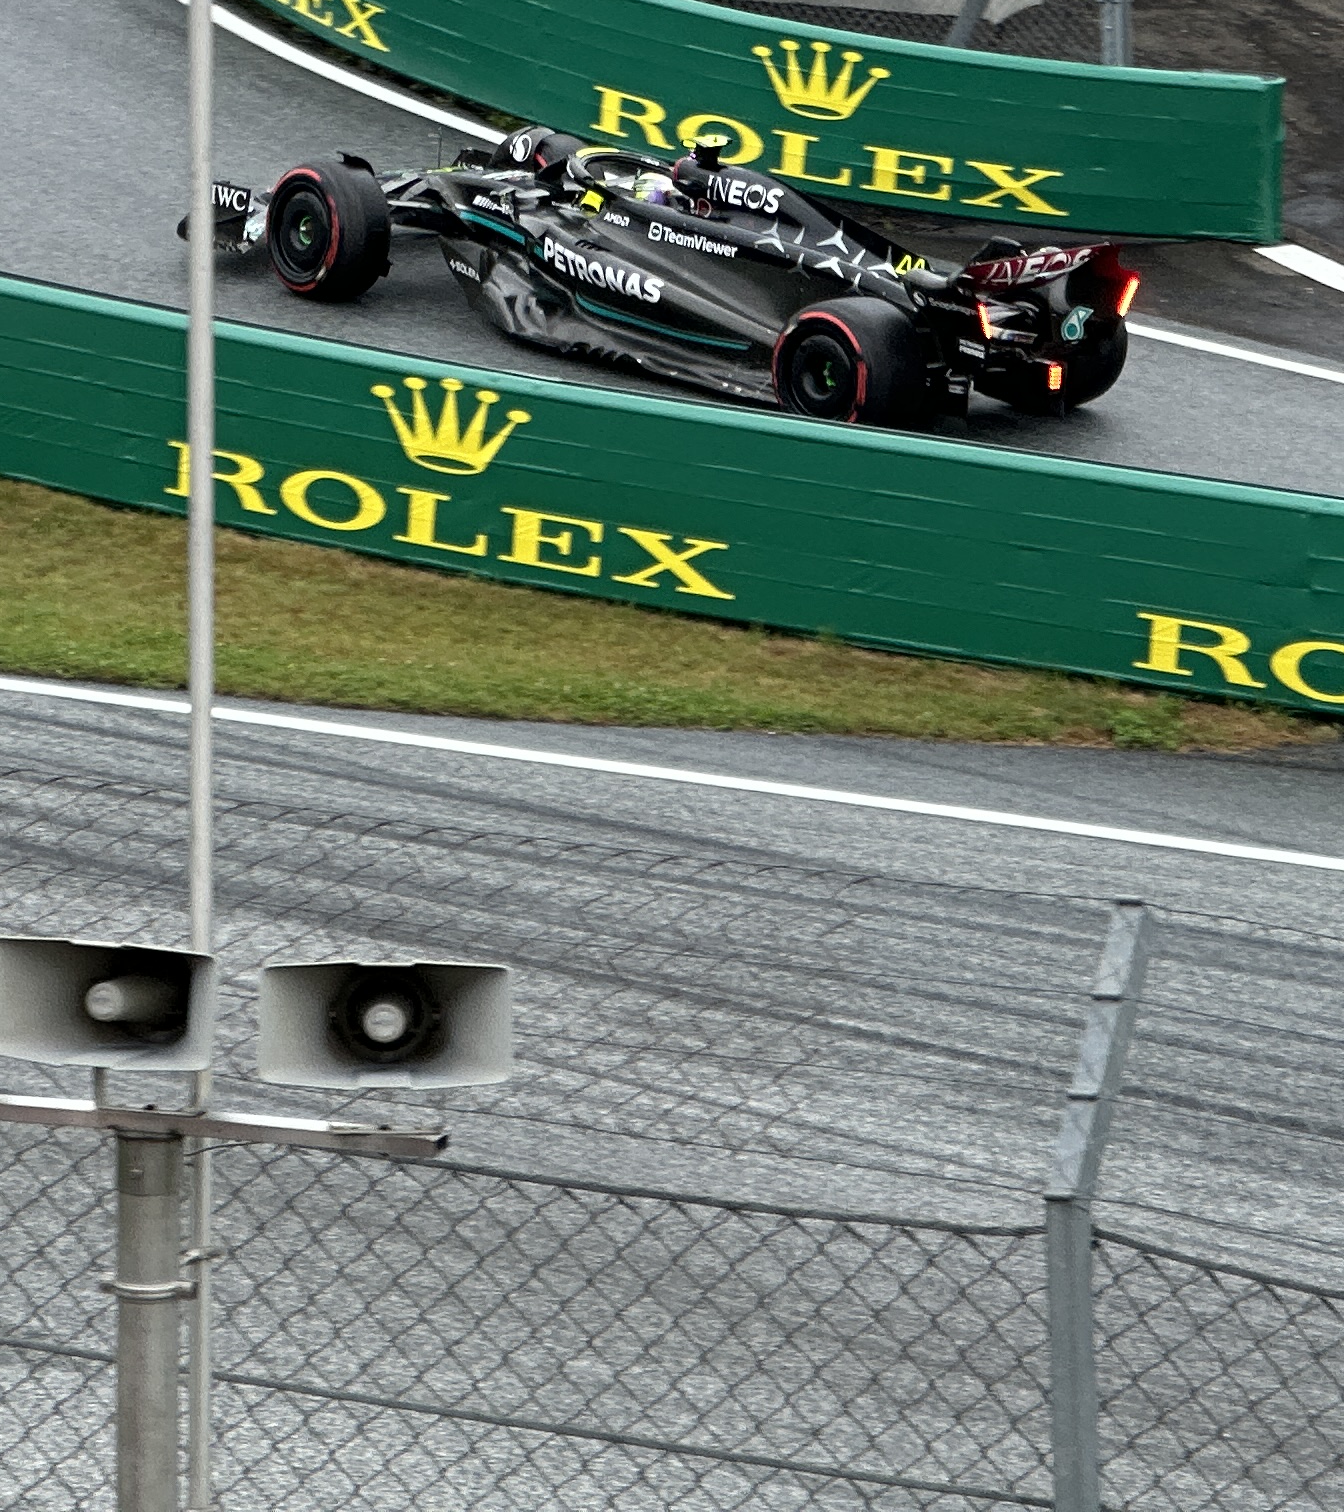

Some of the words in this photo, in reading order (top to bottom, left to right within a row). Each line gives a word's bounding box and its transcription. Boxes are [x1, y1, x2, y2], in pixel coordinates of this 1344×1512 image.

[589, 85, 1069, 216] ROLEX
[211, 184, 248, 211] IWC
[706, 174, 785, 214] INEOS
[662, 226, 738, 259] TeamViewer
[543, 237, 665, 304] PETRONAS
[164, 440, 736, 600] ROLEX
